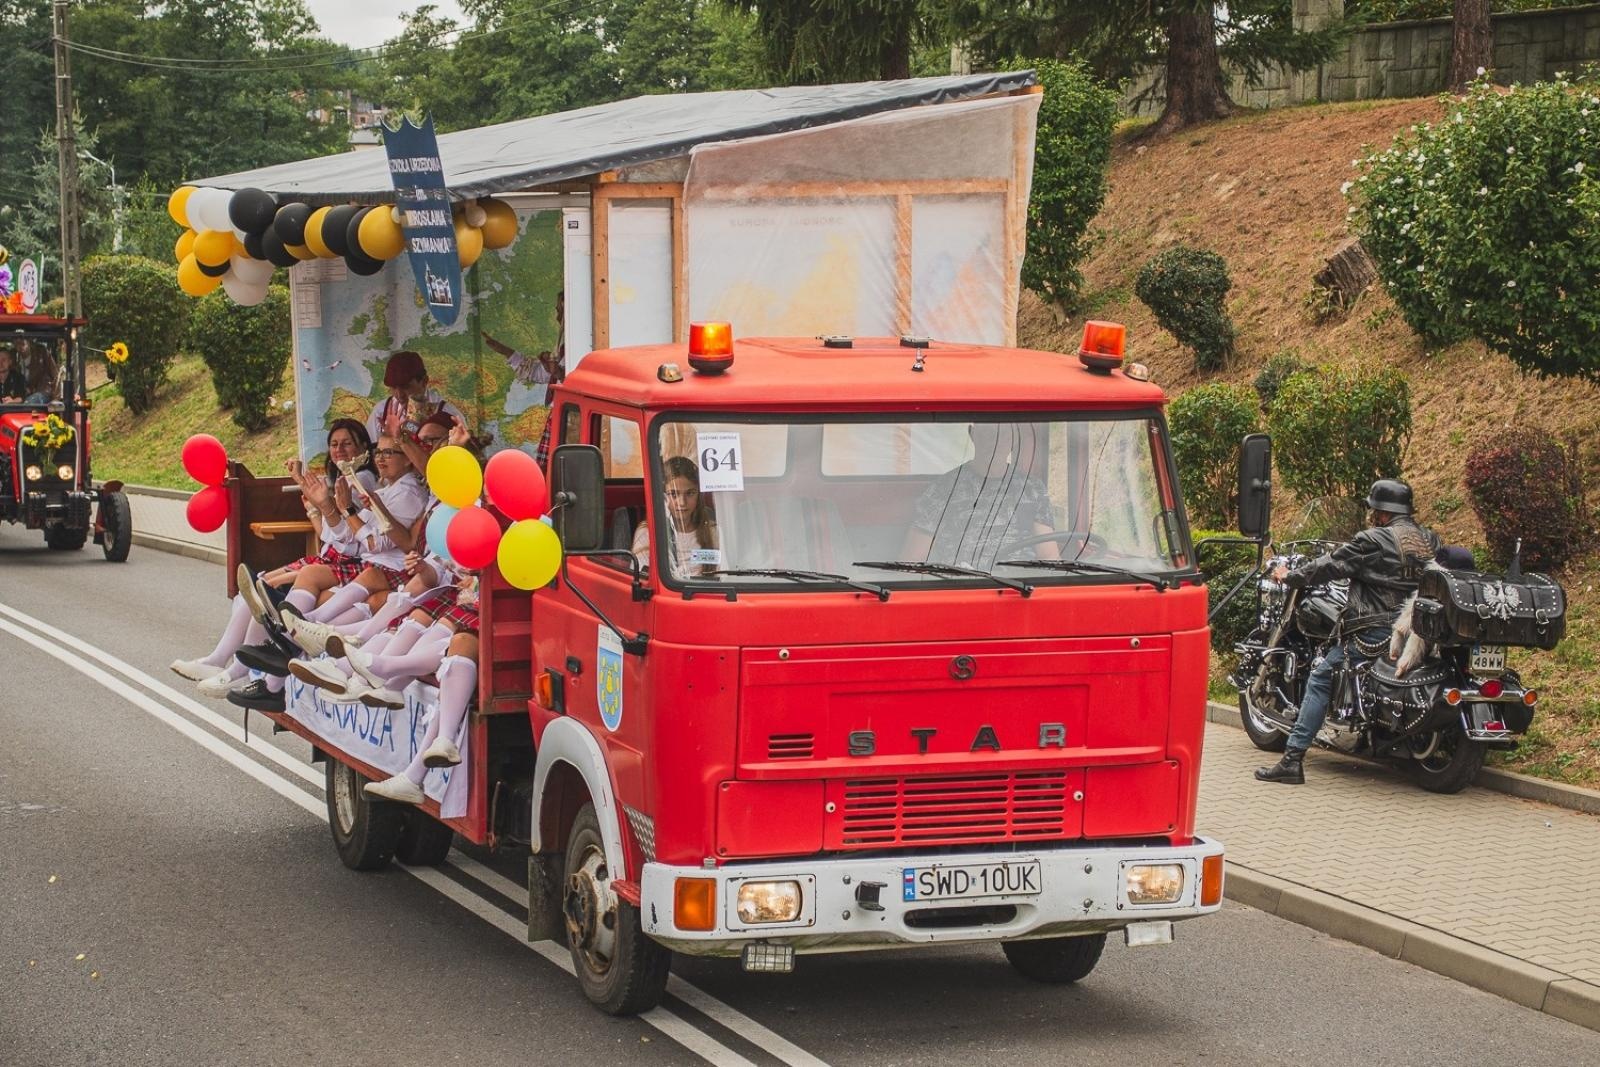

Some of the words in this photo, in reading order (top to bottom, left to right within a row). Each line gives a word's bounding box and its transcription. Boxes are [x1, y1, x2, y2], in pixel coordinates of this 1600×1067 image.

[701, 447, 740, 473] 64
[1474, 656, 1504, 669] 48WW
[848, 722, 1067, 757] STAR
[905, 888, 915, 896] PL
[919, 869, 970, 897] SWD
